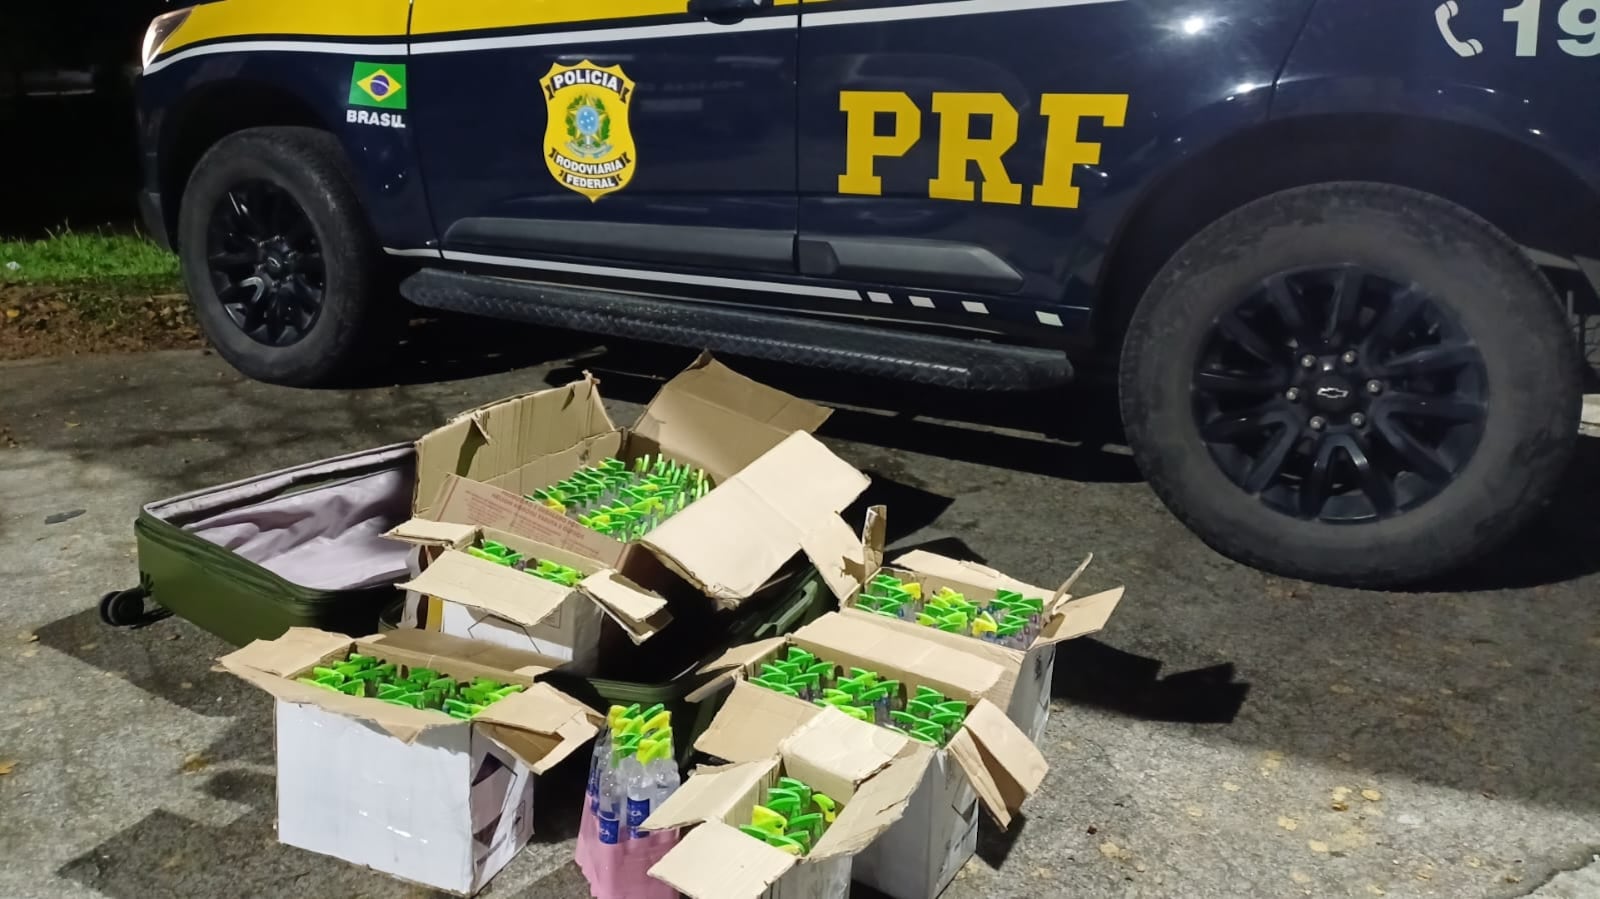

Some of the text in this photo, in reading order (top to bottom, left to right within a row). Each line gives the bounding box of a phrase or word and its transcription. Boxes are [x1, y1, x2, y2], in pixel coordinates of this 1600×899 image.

[1502, 0, 1600, 57] 19
[346, 109, 406, 129] BRASIL
[838, 91, 1129, 209] PRF
[566, 173, 616, 189] FEDERAL
